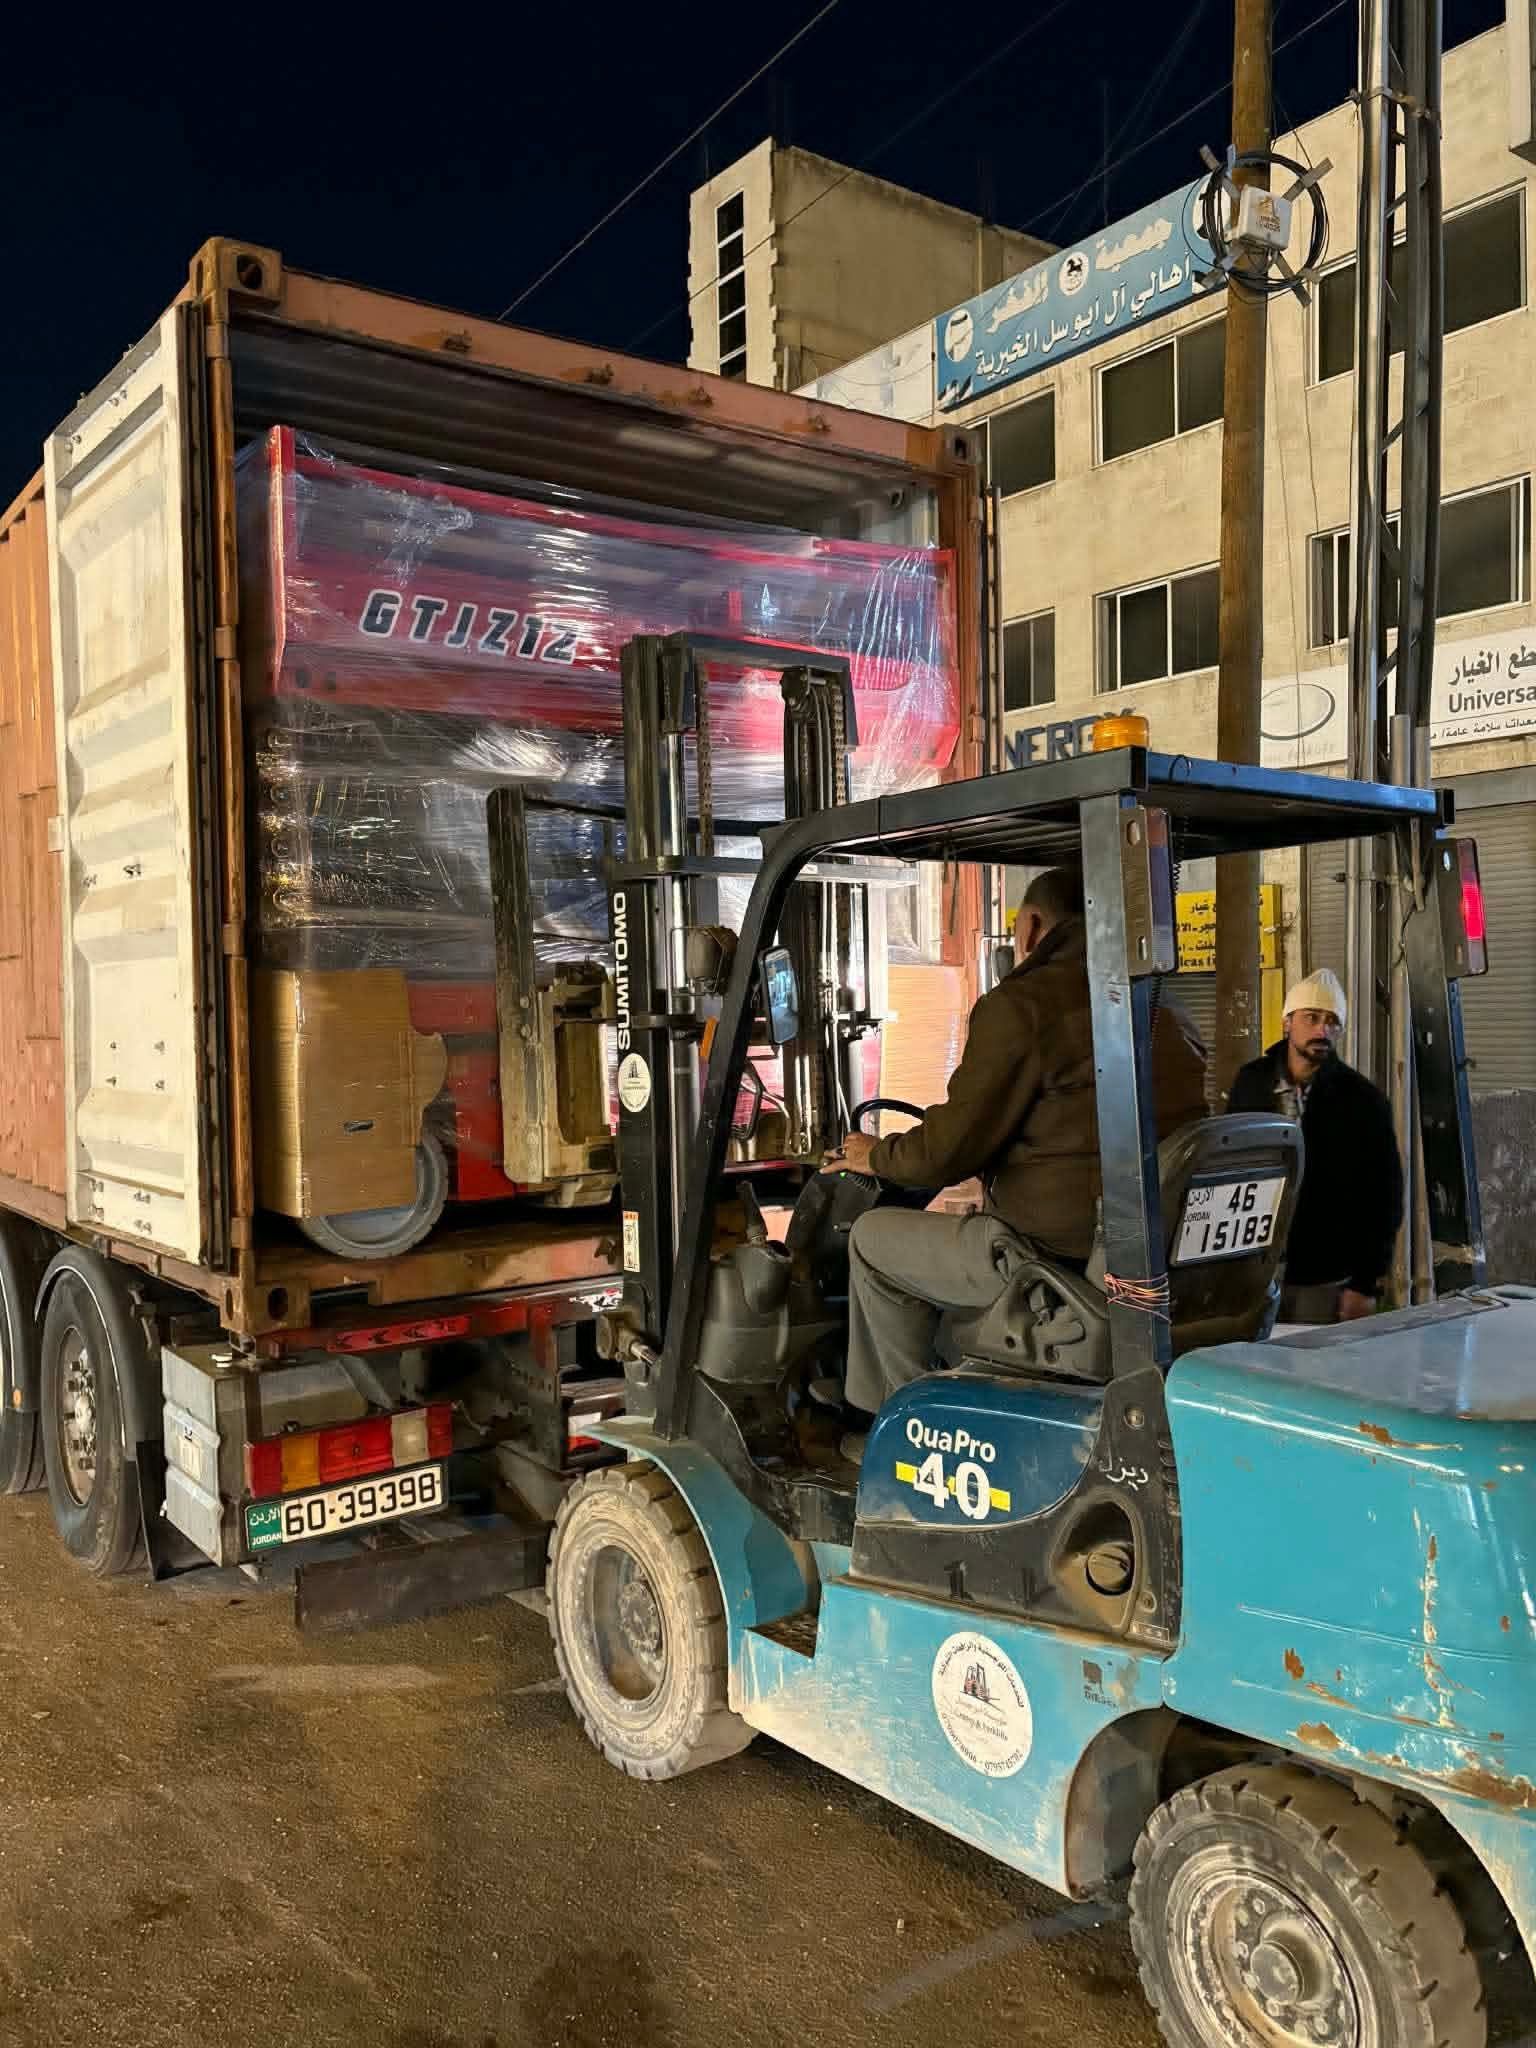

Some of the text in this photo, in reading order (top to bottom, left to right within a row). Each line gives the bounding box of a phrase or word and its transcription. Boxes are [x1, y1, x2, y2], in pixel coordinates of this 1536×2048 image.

[1130, 250, 1190, 320] أهالي
[975, 328, 1038, 380] الخيرية
[360, 588, 578, 665] GTJZ12
[1448, 650, 1500, 686] الغيار
[1449, 685, 1536, 713] Universa
[613, 891, 631, 1051] SUMITOMO
[1228, 1183, 1257, 1213] 46
[1200, 1215, 1273, 1253] 15183
[905, 1417, 997, 1463] QuaPro
[913, 1451, 991, 1520] 40
[252, 1533, 282, 1546] JORDAN
